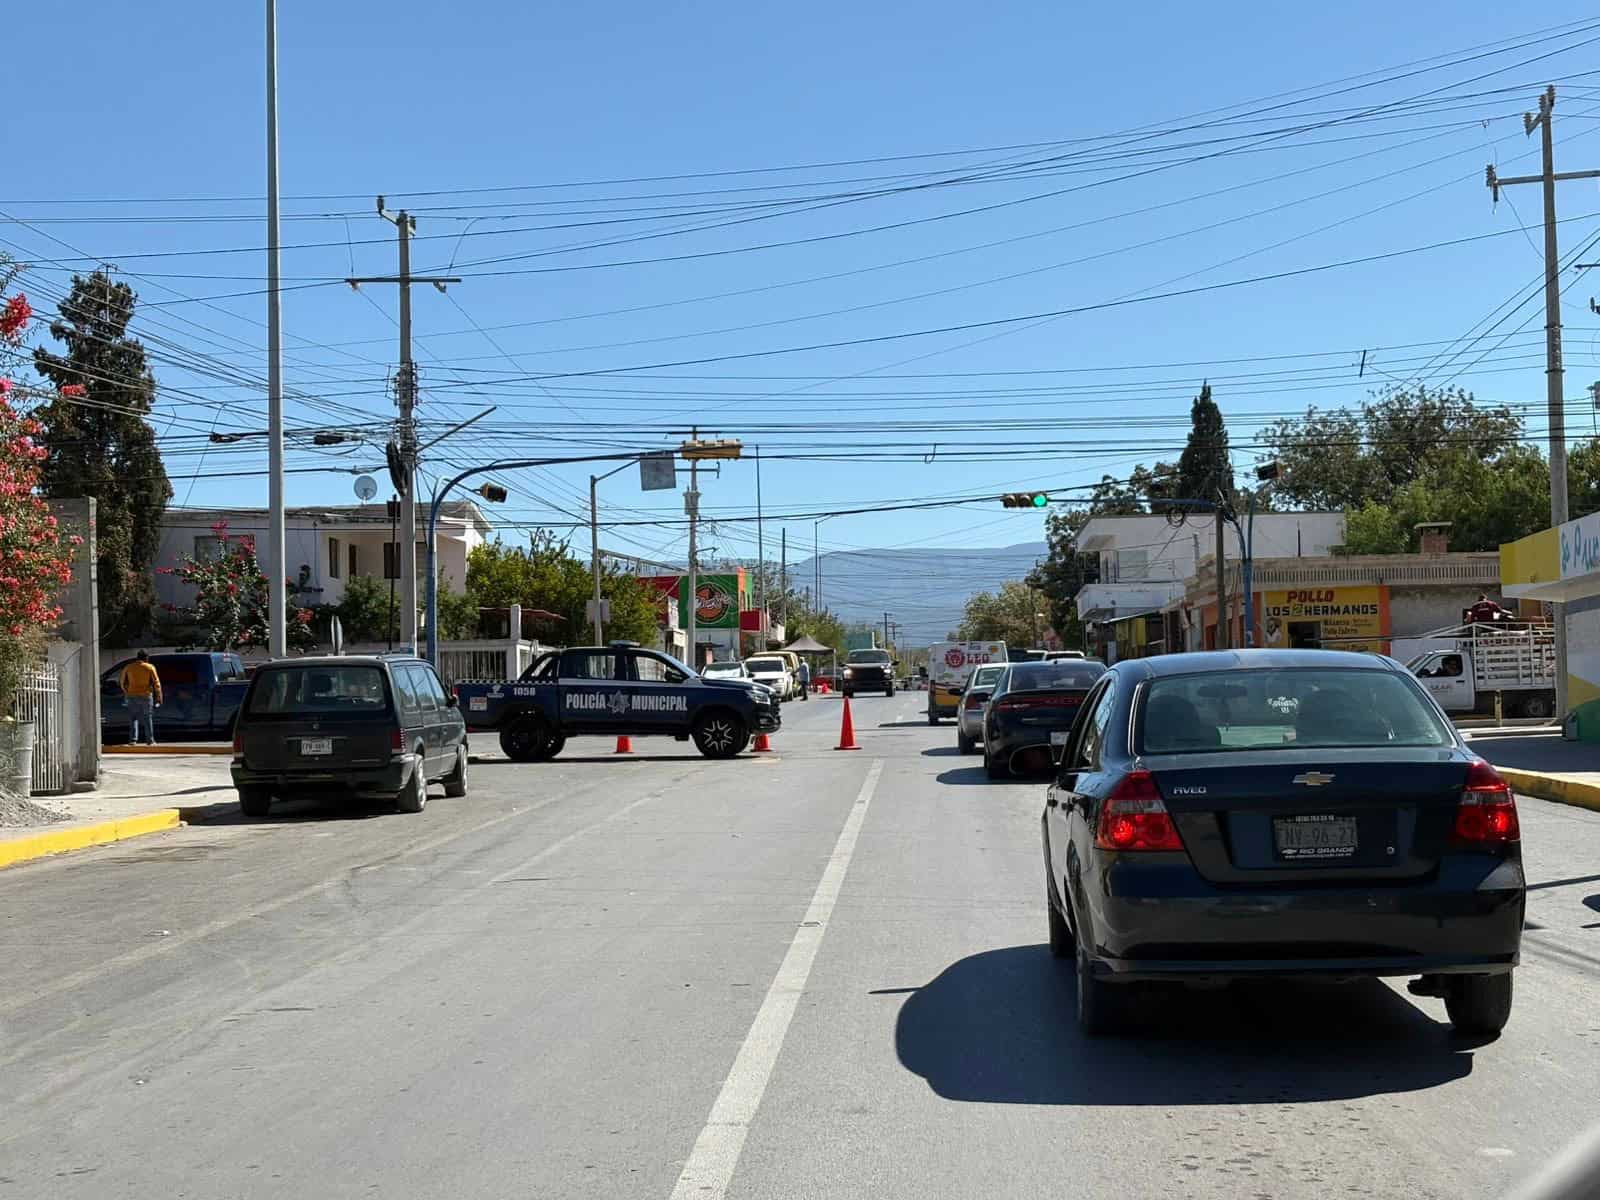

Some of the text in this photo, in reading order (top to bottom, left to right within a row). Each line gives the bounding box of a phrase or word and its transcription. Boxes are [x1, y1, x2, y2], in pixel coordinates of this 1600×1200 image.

[1287, 590, 1334, 603] POLLO
[1266, 606, 1290, 616] LOS
[1304, 604, 1378, 616] HERMANOS
[566, 691, 688, 711] POLICÍA MUNICIPAL
[1173, 786, 1207, 794] AVEO
